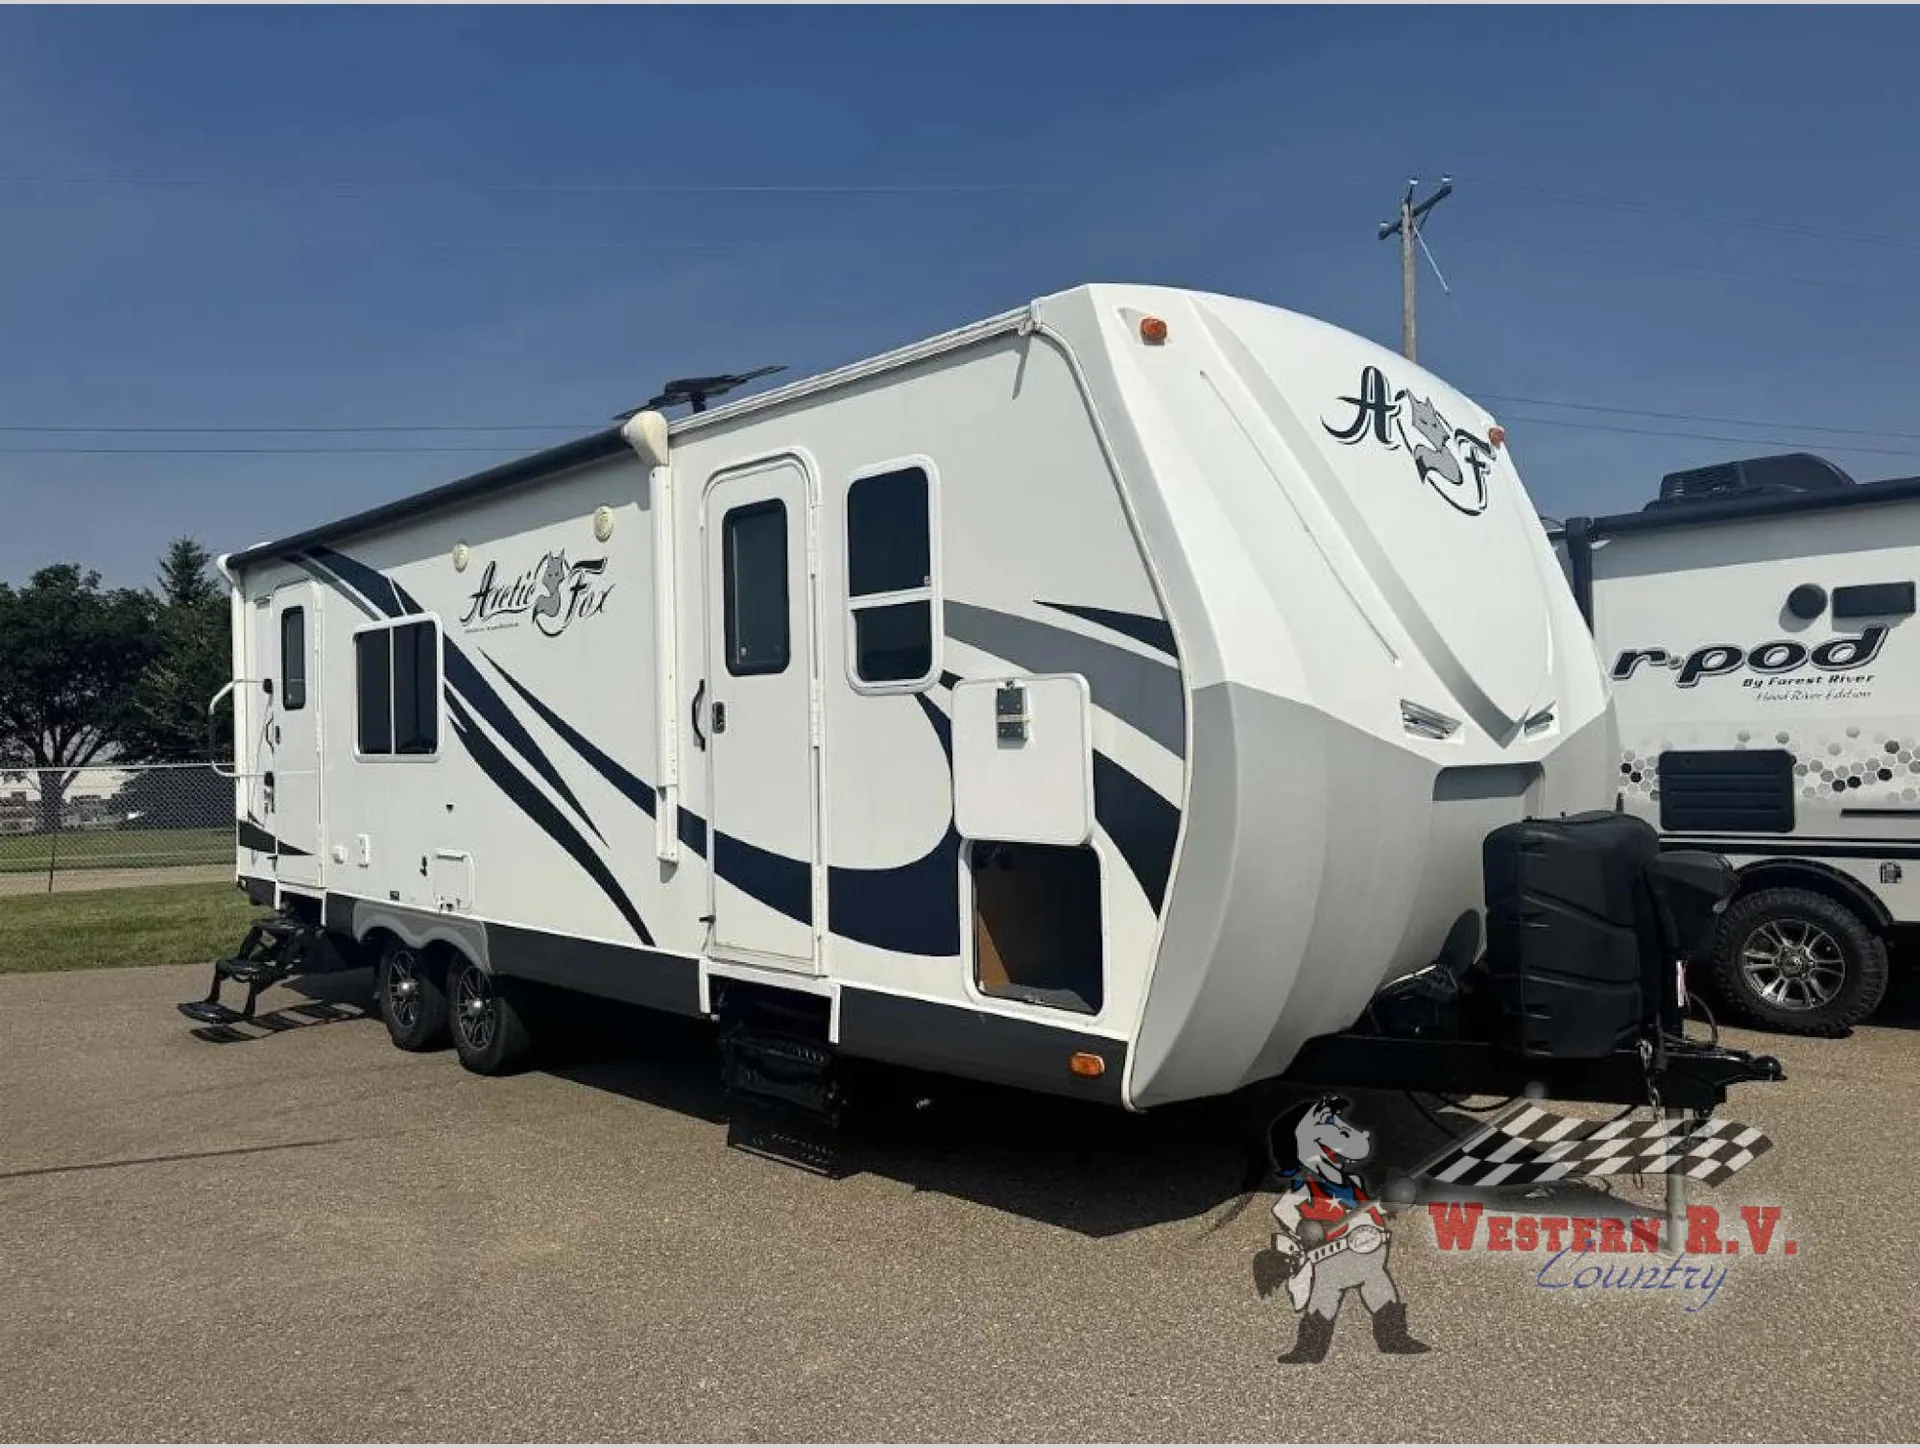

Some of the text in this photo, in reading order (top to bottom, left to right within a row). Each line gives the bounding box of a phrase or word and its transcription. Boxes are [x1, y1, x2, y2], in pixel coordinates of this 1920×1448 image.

[460, 556, 616, 630] Arctic Fox
[1742, 674, 1874, 688] By Forest River
